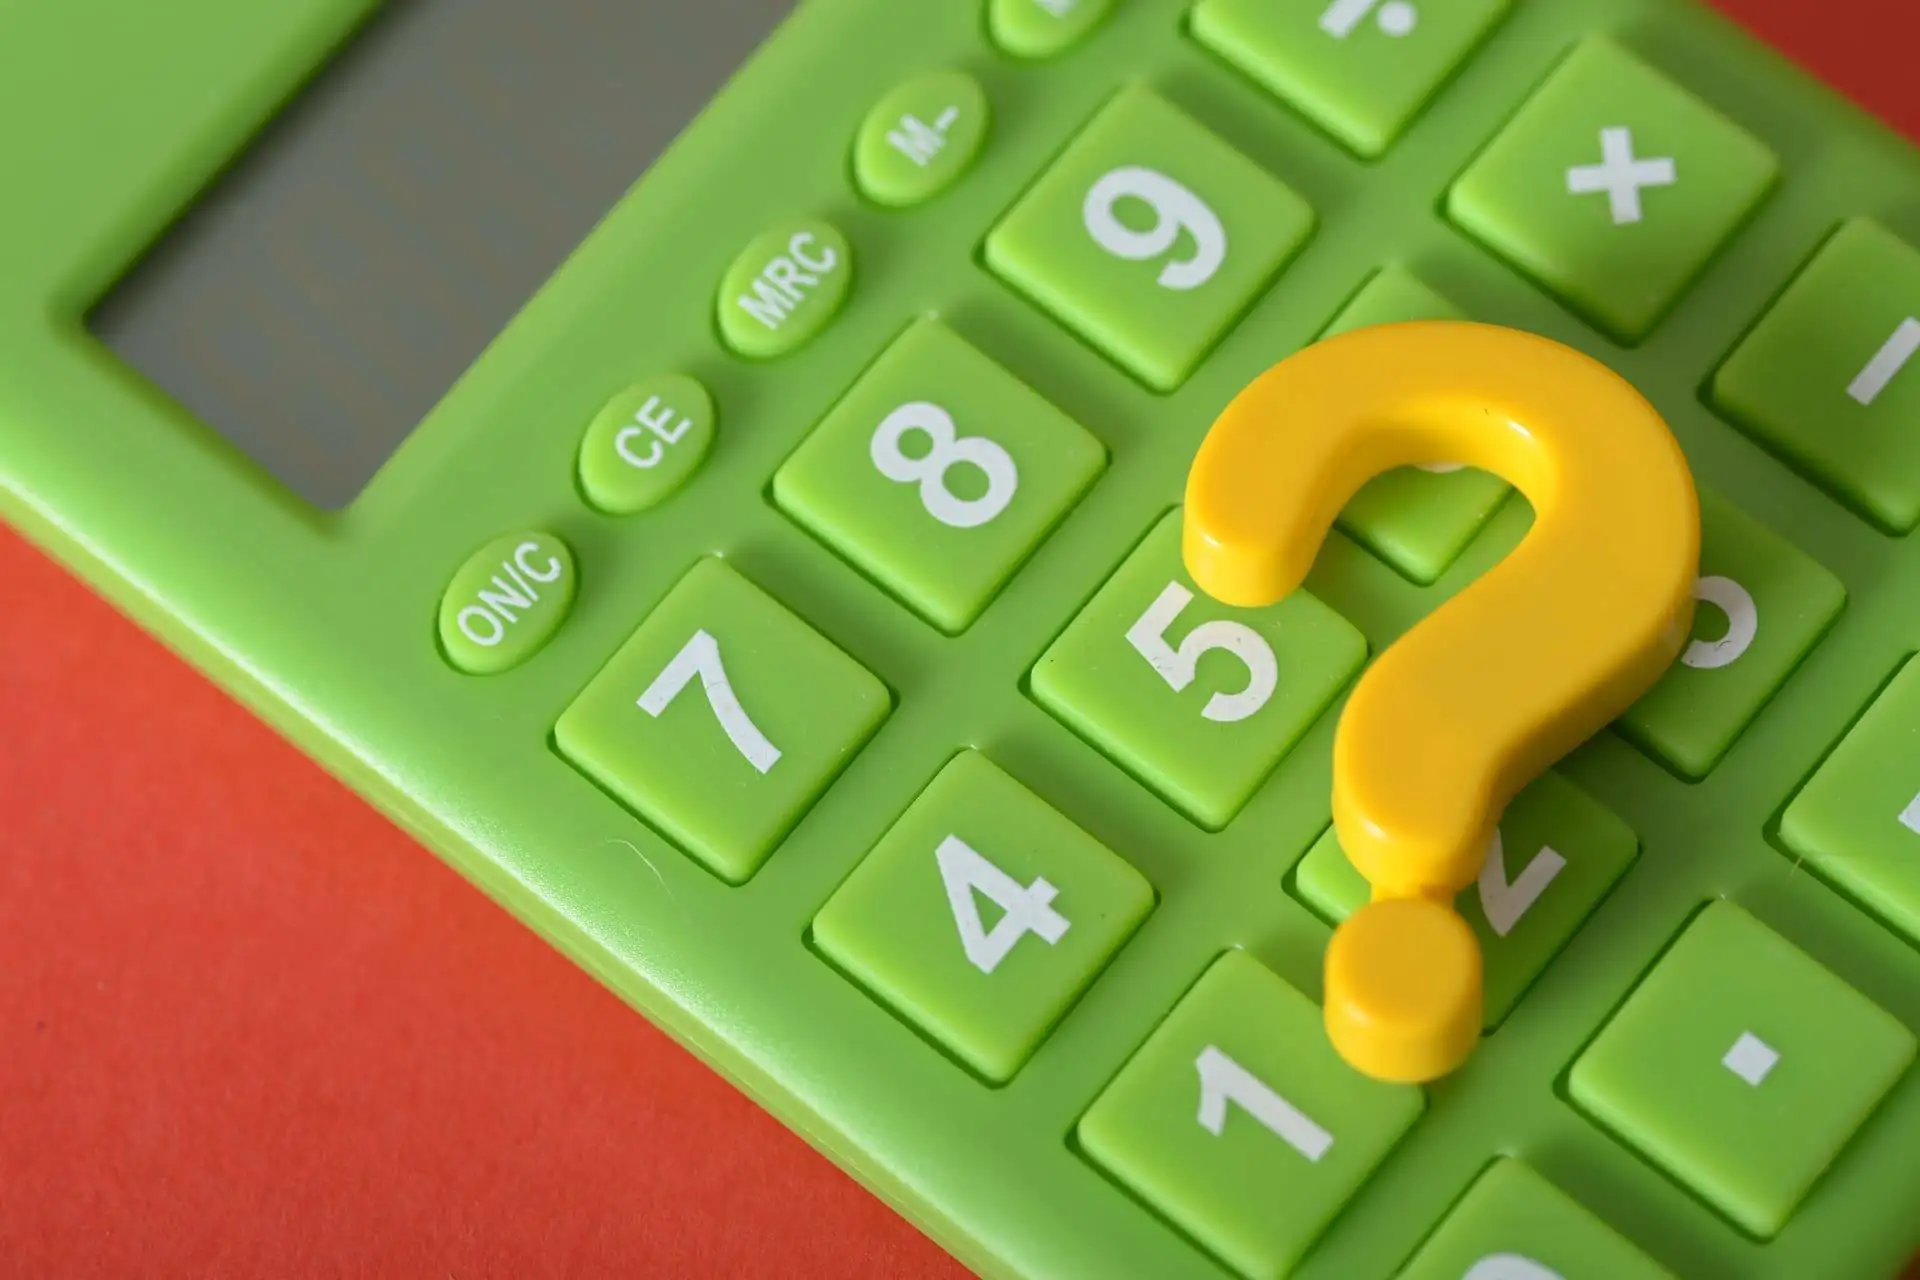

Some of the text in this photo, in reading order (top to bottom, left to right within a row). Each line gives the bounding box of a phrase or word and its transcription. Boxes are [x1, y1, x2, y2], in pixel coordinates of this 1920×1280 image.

[738, 232, 837, 329] MRC
[1083, 166, 1227, 290] 9
[615, 395, 692, 469] CE
[870, 401, 1018, 528] 8
[458, 541, 562, 646] ON/C
[1125, 579, 1278, 722] 5
[636, 629, 782, 774] 7
[935, 834, 1071, 974] 4
[1195, 1045, 1333, 1162] 1
